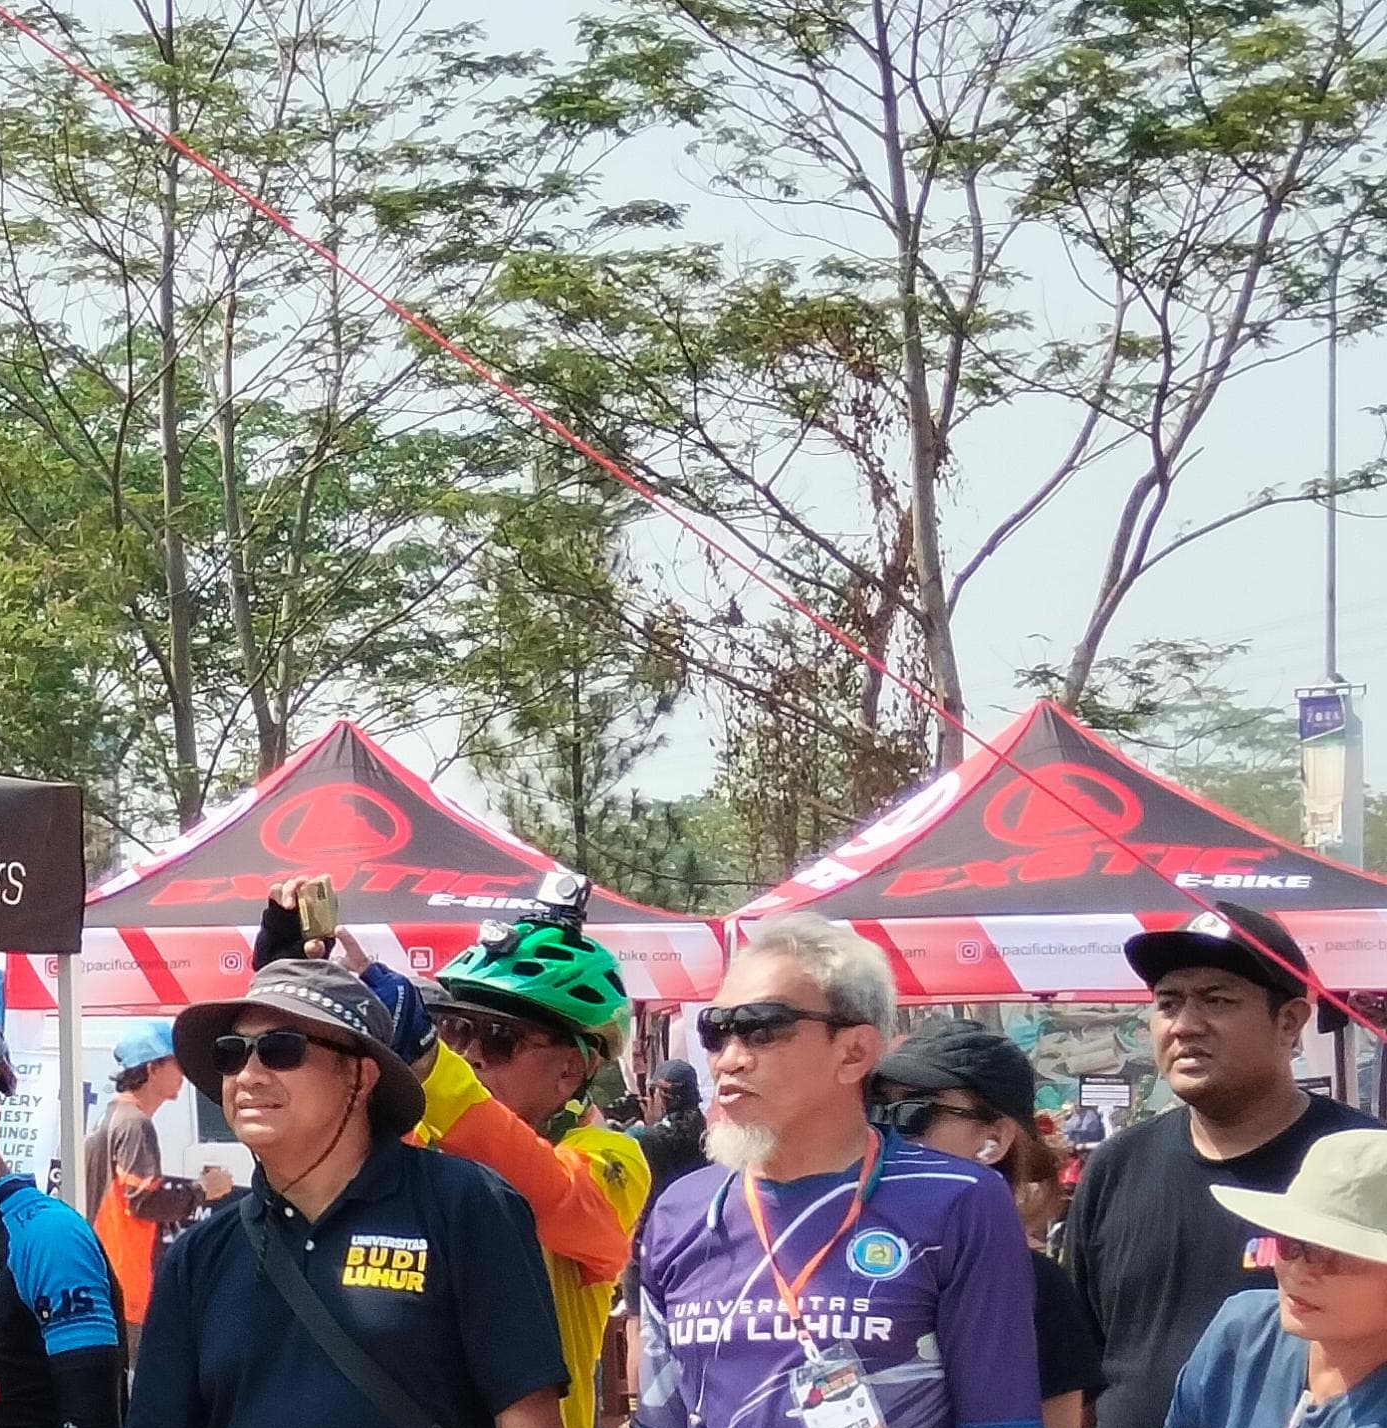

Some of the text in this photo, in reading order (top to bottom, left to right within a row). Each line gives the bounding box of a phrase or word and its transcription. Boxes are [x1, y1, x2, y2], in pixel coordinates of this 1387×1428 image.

[881, 845, 1280, 897] EXOTIC
[1174, 872, 1313, 890] E-BIKE
[3, 1144, 35, 1158] LIFE
[351, 1234, 428, 1251] UNIVERSITAS
[346, 1246, 427, 1272] BUDI
[342, 1265, 426, 1293] LUHUR
[746, 1314, 893, 1343] LUHUR
